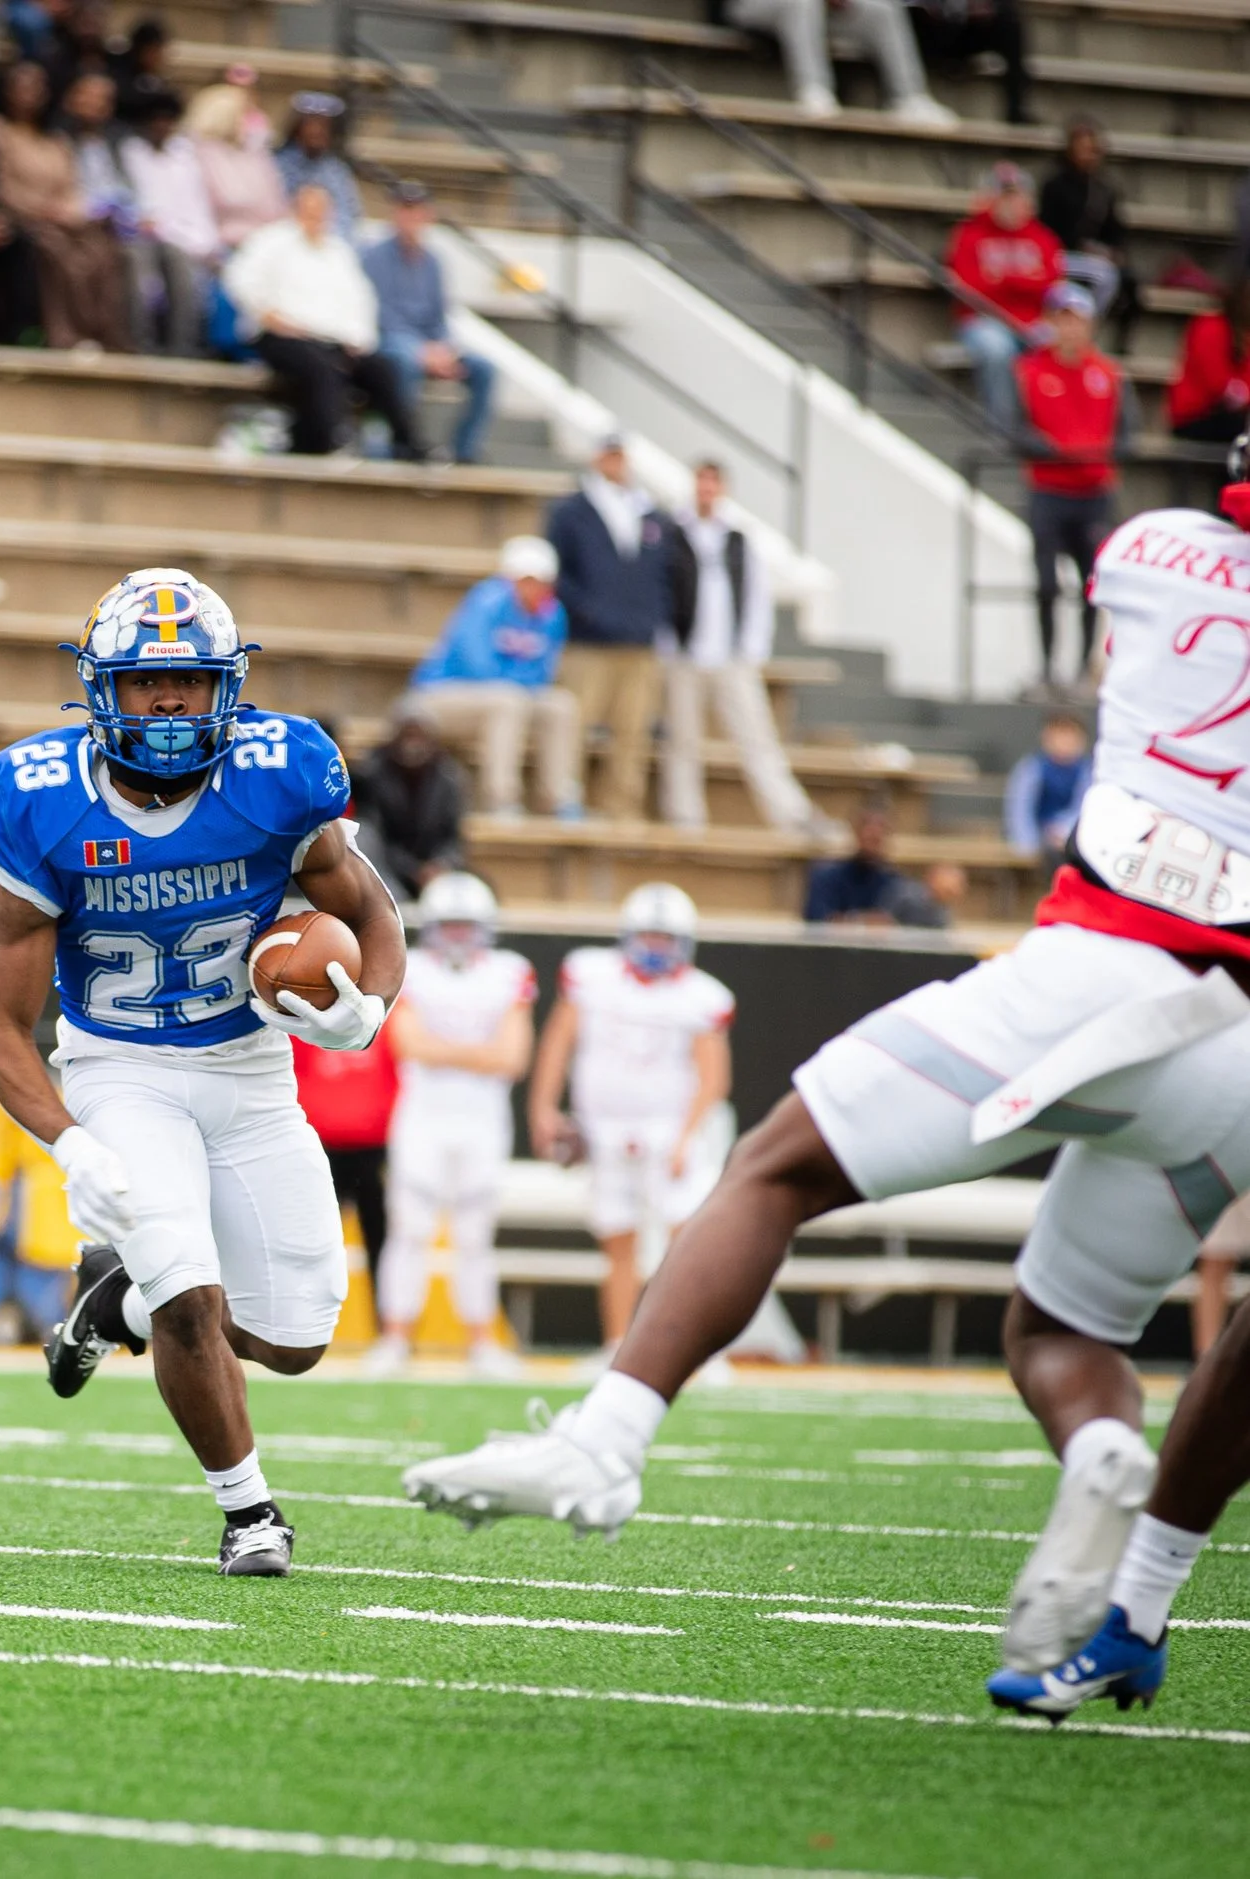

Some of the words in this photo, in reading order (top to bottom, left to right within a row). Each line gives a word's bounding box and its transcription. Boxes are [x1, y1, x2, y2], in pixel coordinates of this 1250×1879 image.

[1119, 528, 1250, 593] KIRK
[9, 740, 71, 792] 23
[233, 718, 288, 770] 23
[83, 858, 248, 913] MISSISSIPPI
[77, 910, 261, 1030] 23
